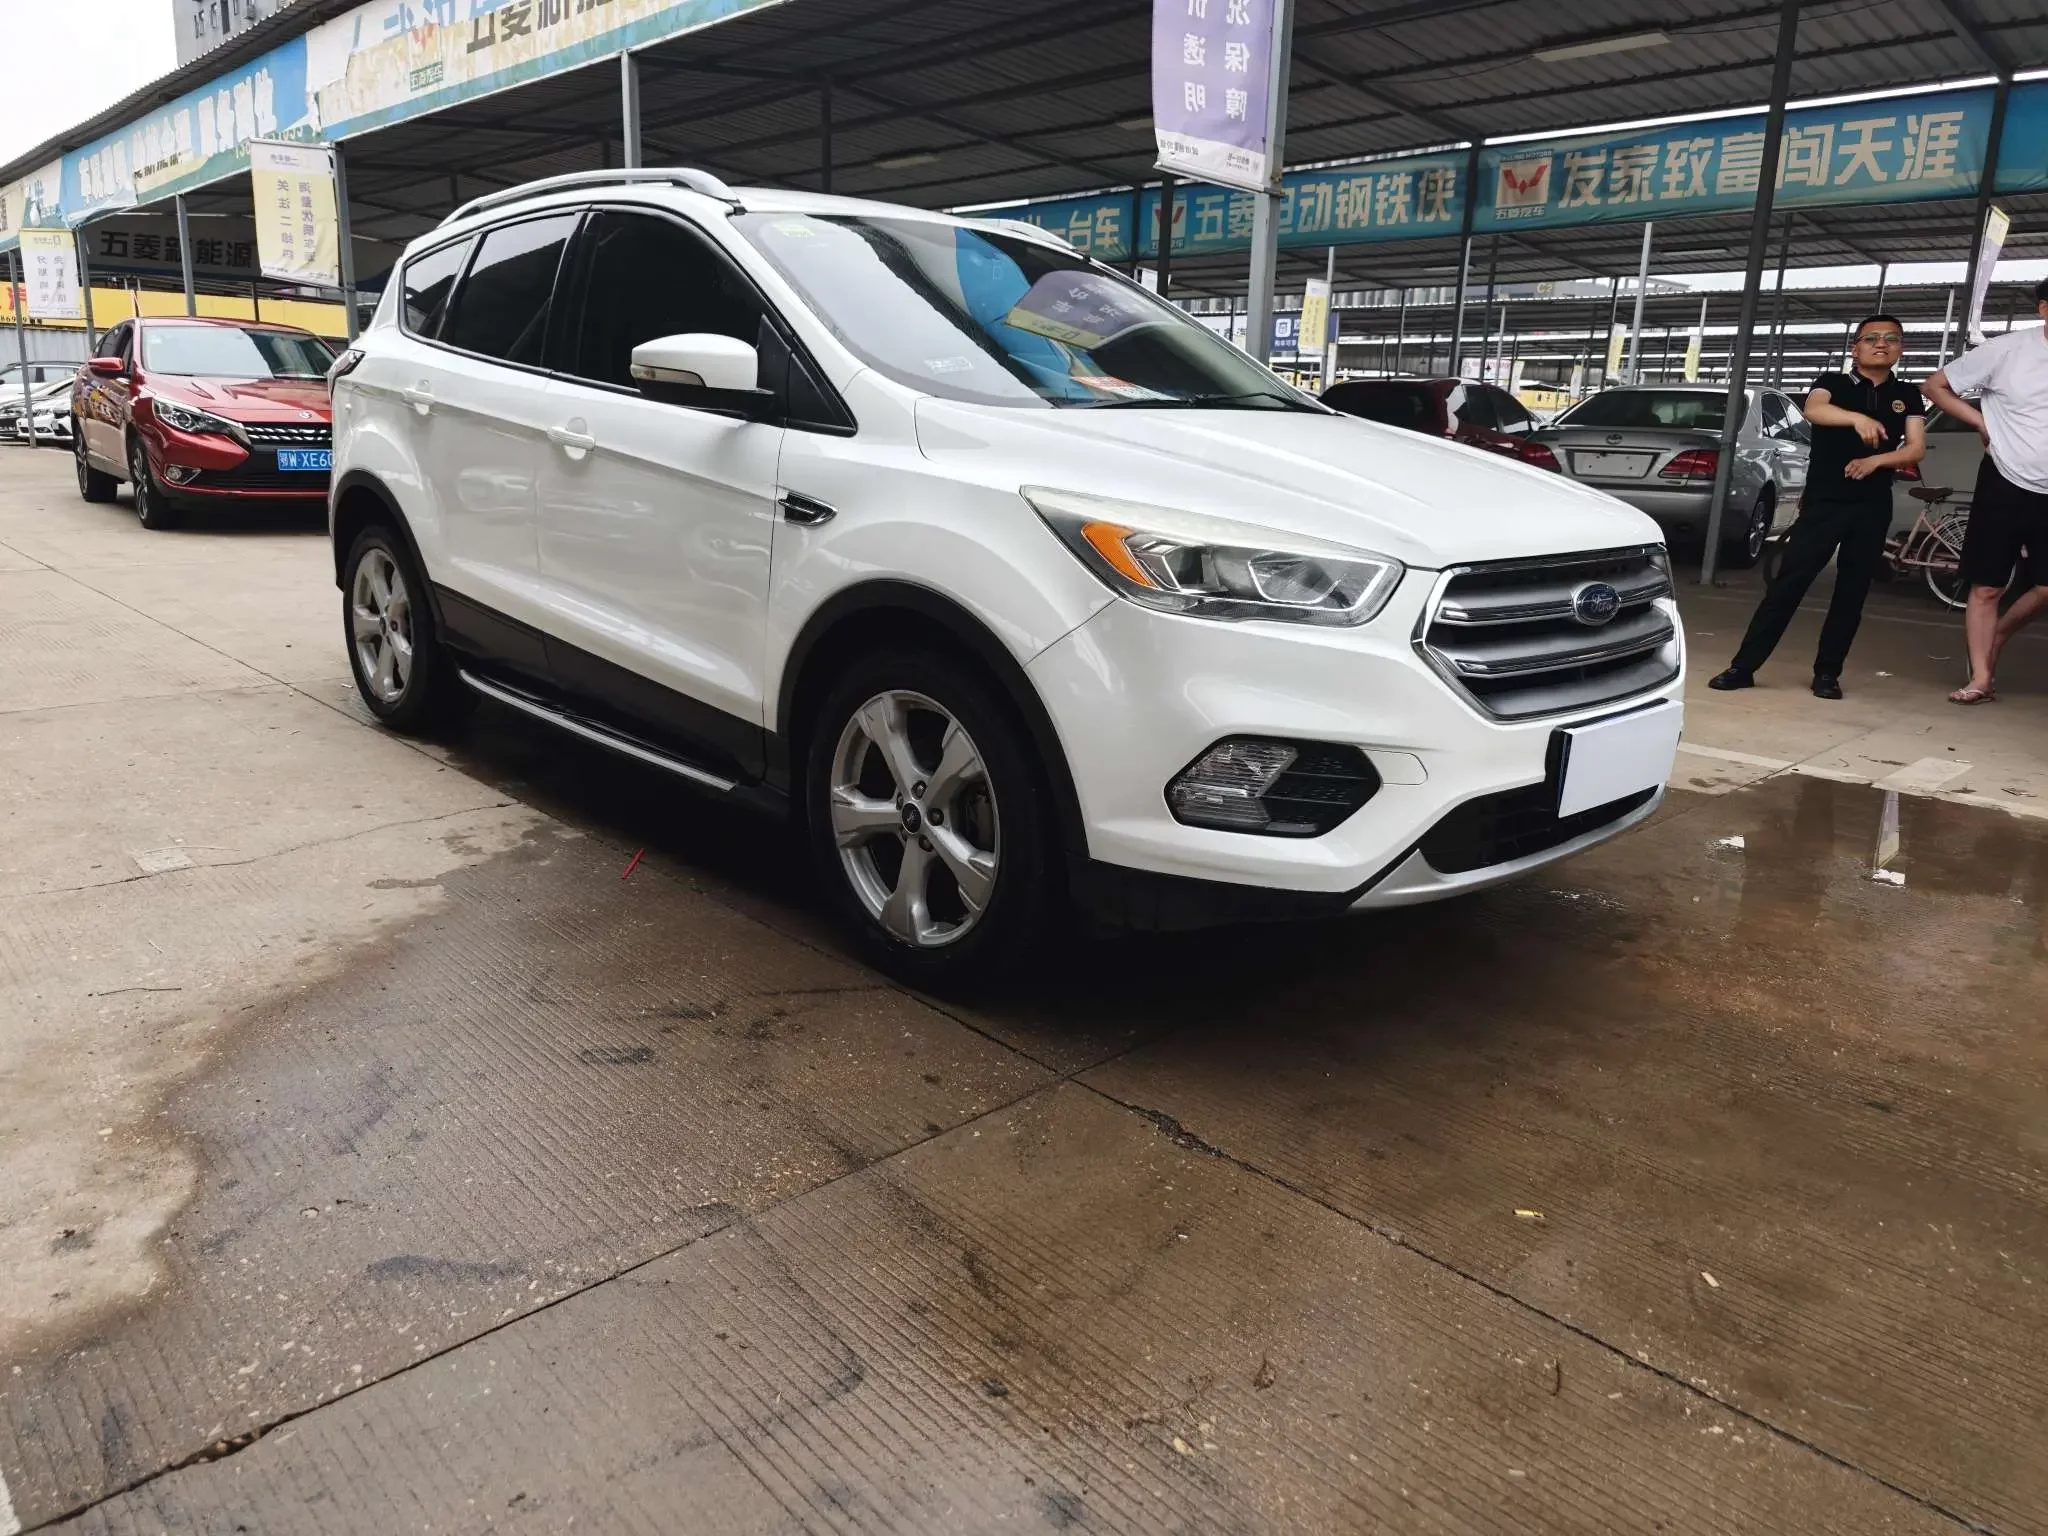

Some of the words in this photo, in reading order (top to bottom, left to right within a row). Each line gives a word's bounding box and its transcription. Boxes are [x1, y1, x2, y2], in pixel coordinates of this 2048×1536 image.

[1557, 110, 1965, 209] 发家致富闯天涯
[100, 230, 251, 269] 五菱新能源
